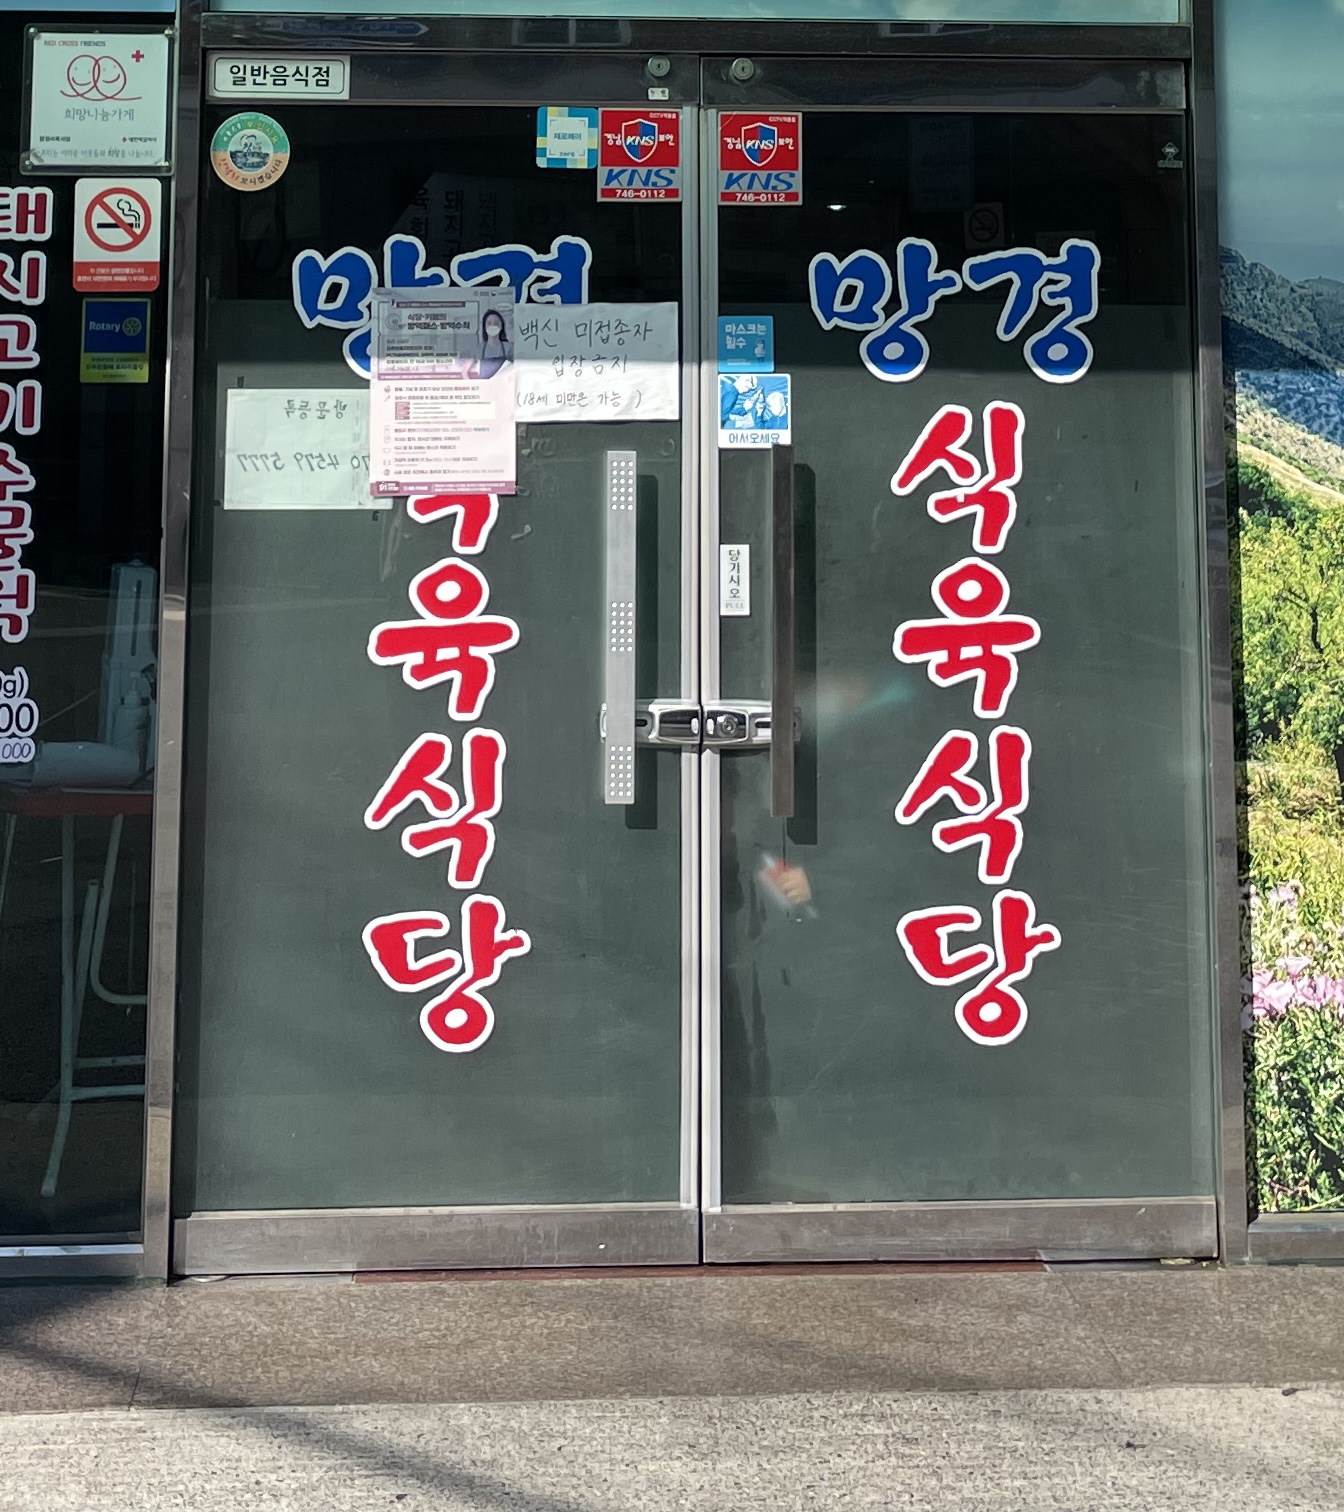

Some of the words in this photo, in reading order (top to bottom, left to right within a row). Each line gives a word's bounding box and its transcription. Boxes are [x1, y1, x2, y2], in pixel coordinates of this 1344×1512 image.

[229, 64, 331, 88] 일반음식점
[625, 135, 655, 146] KNS
[745, 139, 775, 150] KNS
[604, 168, 677, 188] KNS
[724, 172, 796, 192] KNS
[615, 188, 666, 198] 746-0112
[735, 192, 786, 202] 746-0112
[810, 239, 1101, 384] 망경
[88, 320, 121, 334] Rotary
[519, 318, 559, 350] 백신
[574, 318, 653, 348] 미접종자
[724, 322, 767, 336] 마스크는
[725, 334, 747, 350] 필수
[552, 354, 628, 378] 입장금지
[728, 432, 780, 444] 어서오세요
[728, 548, 741, 599] 당기시오
[891, 400, 1061, 1047] 식육식당
